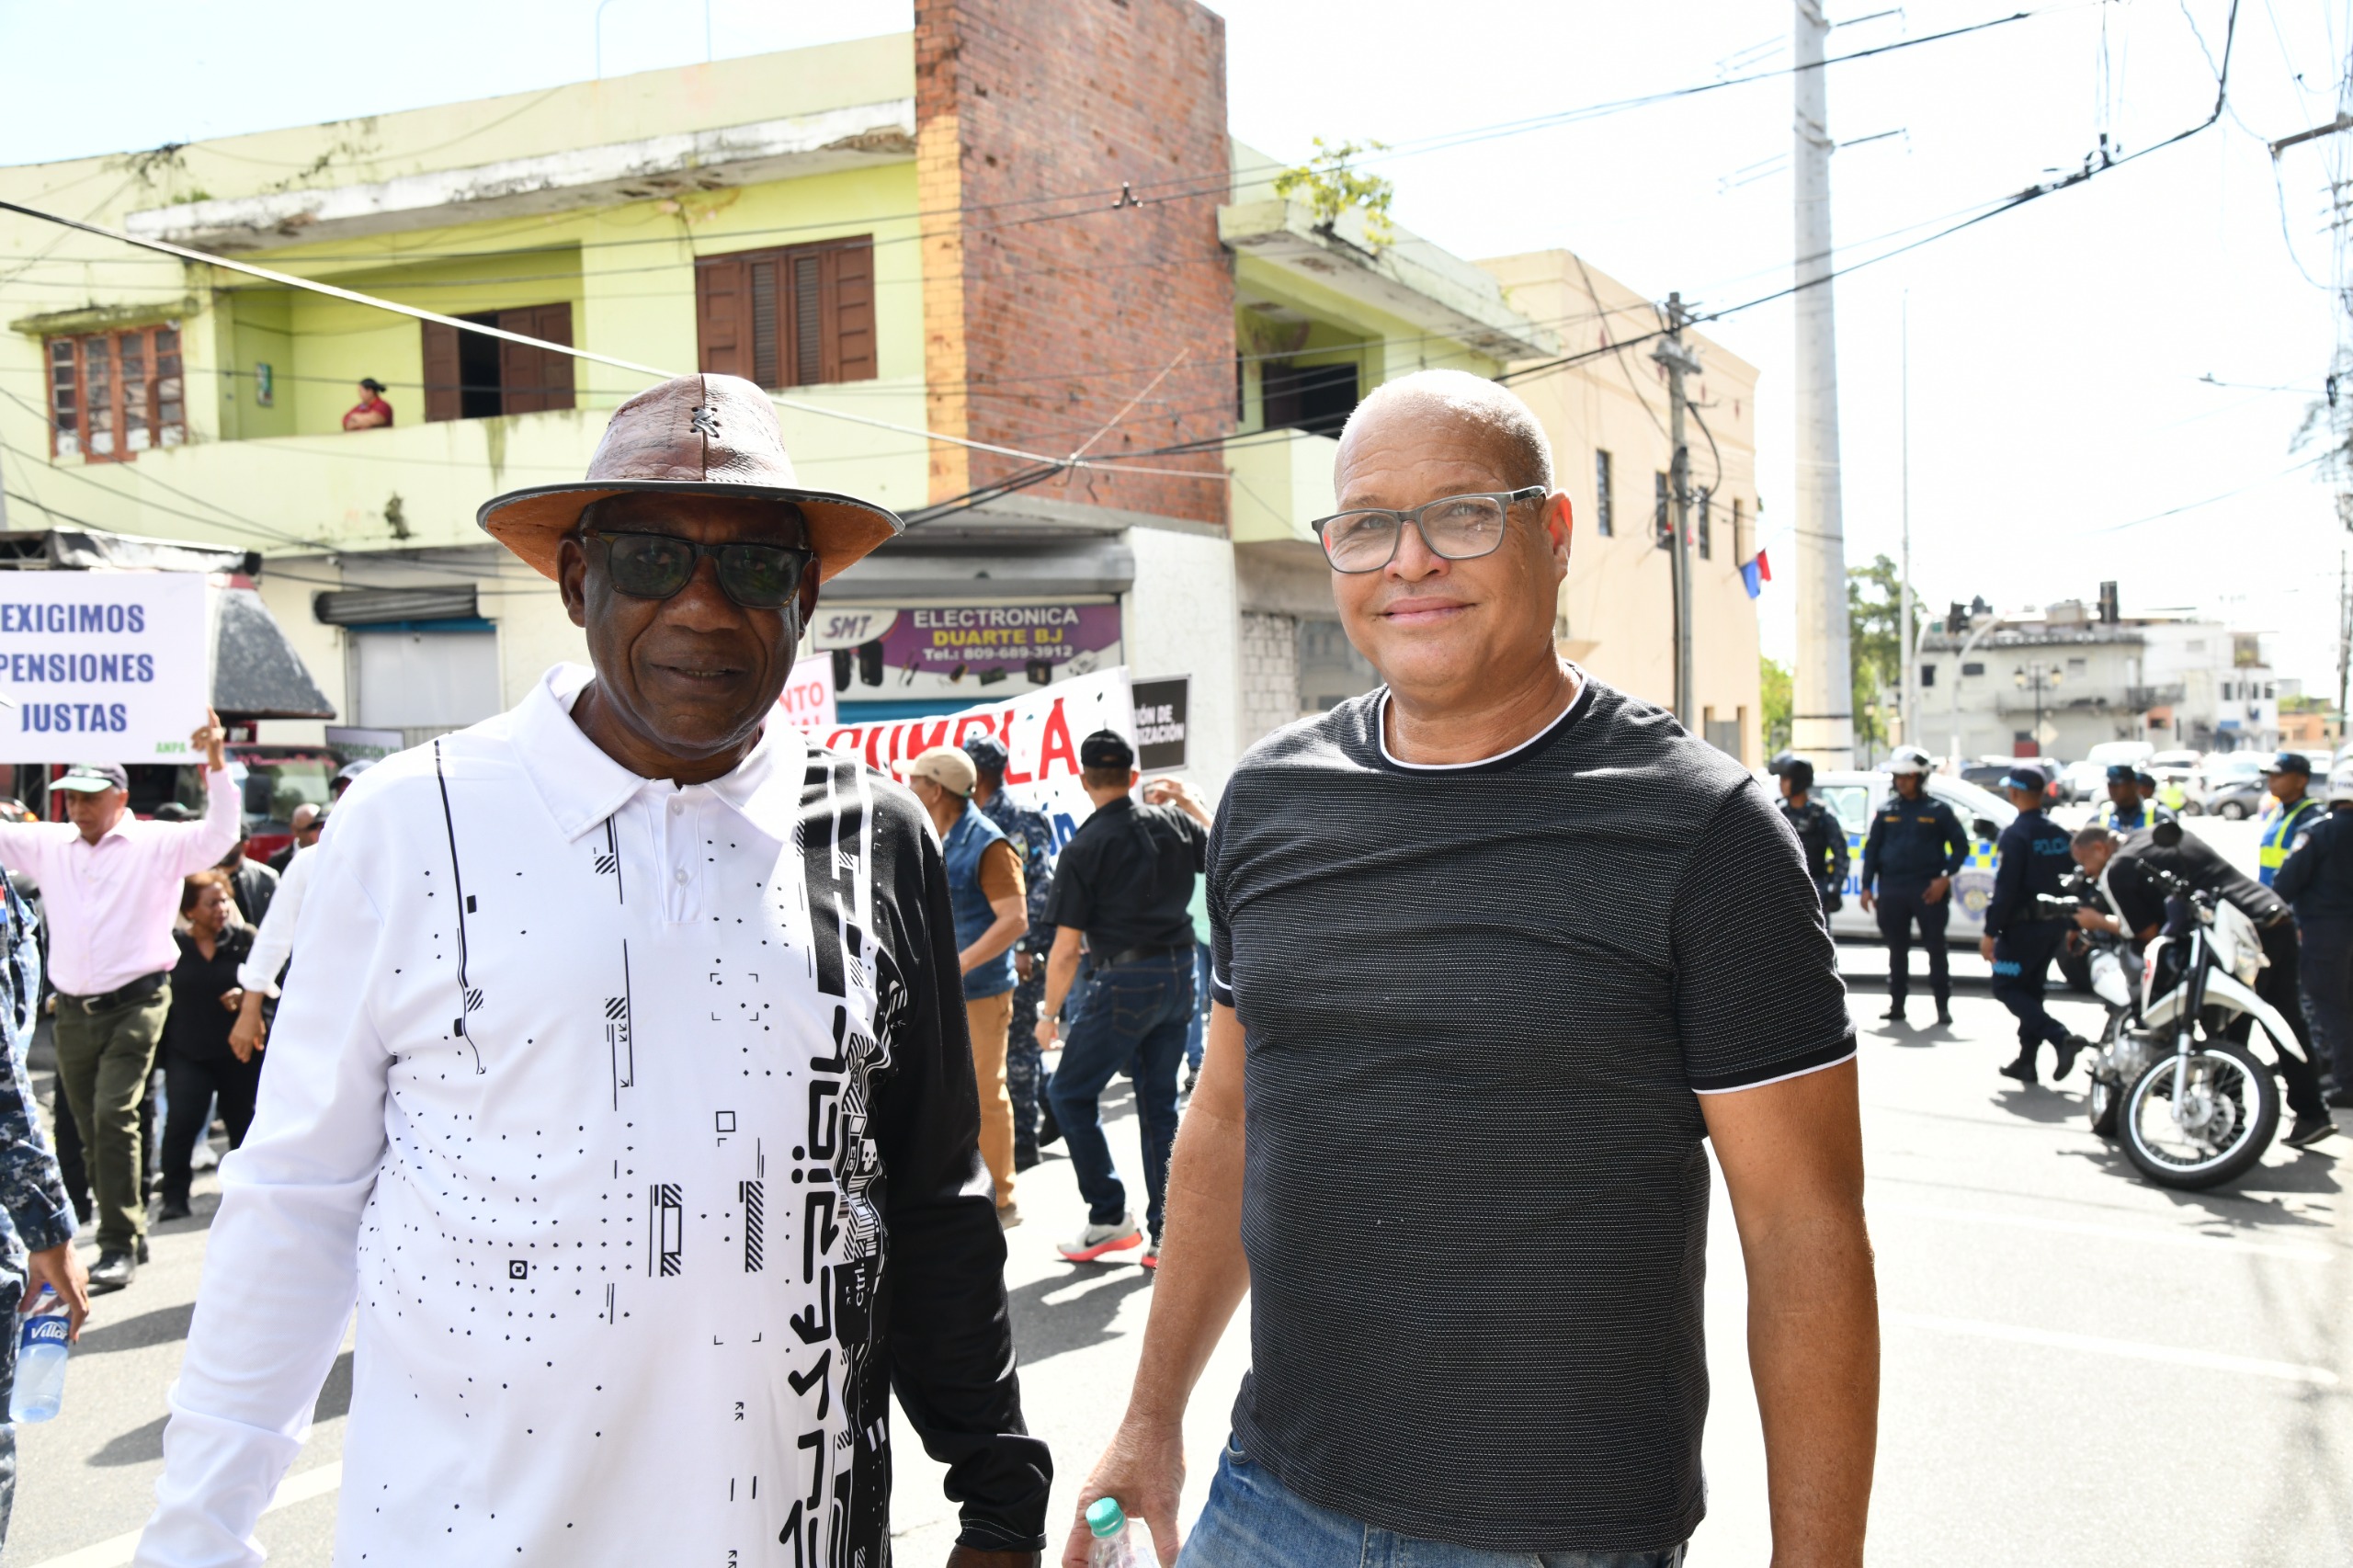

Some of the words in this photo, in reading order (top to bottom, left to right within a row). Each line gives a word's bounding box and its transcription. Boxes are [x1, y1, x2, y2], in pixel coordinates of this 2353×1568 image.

[1, 604, 145, 633] EXIGIMOS
[914, 608, 1079, 629] ELECTRONICA
[933, 629, 1027, 647] DUARTE
[1035, 628, 1063, 643] BJ
[923, 648, 959, 662] Tel.:
[779, 681, 824, 713] NTO
[22, 703, 127, 733] JUSTAS
[1135, 706, 1155, 726] IÓN
[1157, 704, 1173, 723] DE
